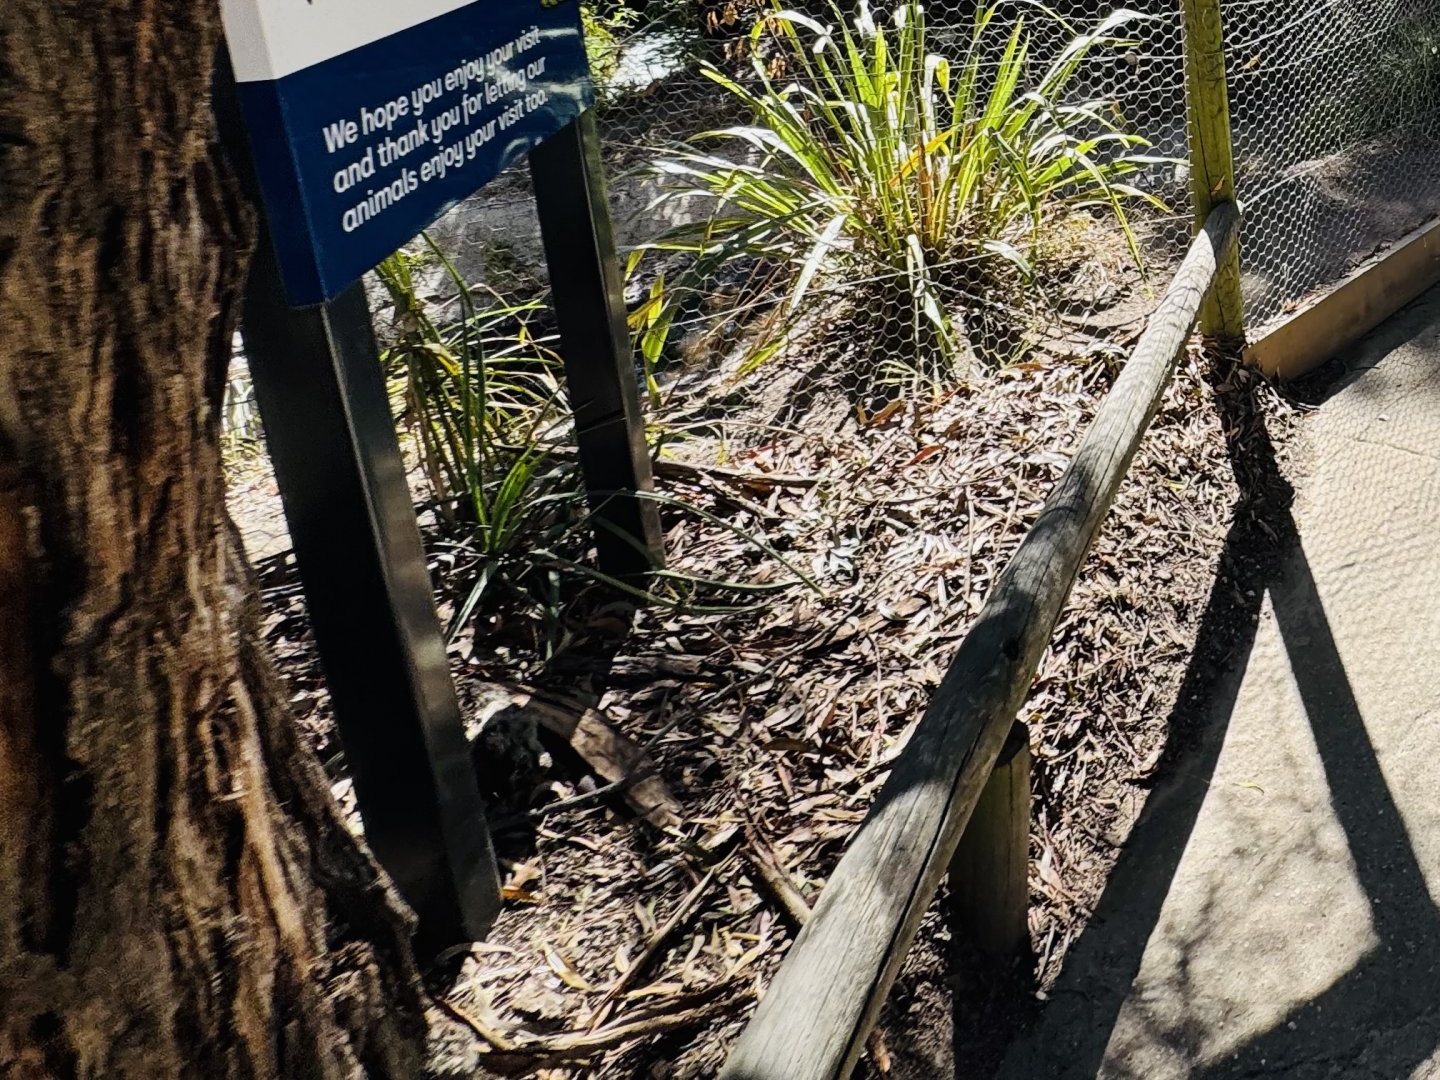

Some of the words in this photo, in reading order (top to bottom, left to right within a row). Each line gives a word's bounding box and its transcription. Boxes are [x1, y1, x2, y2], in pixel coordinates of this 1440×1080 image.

[322, 119, 358, 154] We
[360, 96, 409, 136] hope
[411, 78, 444, 116] you
[444, 56, 484, 92] enjoy
[485, 41, 515, 76] your
[515, 25, 541, 54] visit
[333, 147, 376, 194] and
[377, 119, 430, 167] thank
[431, 106, 460, 144] you
[462, 92, 484, 126] for
[484, 70, 526, 105] letting
[527, 57, 546, 80] our
[342, 168, 418, 233] animals
[420, 141, 464, 182] enjoy
[465, 120, 496, 160] your
[498, 99, 525, 131] visit
[525, 89, 549, 113] too.
